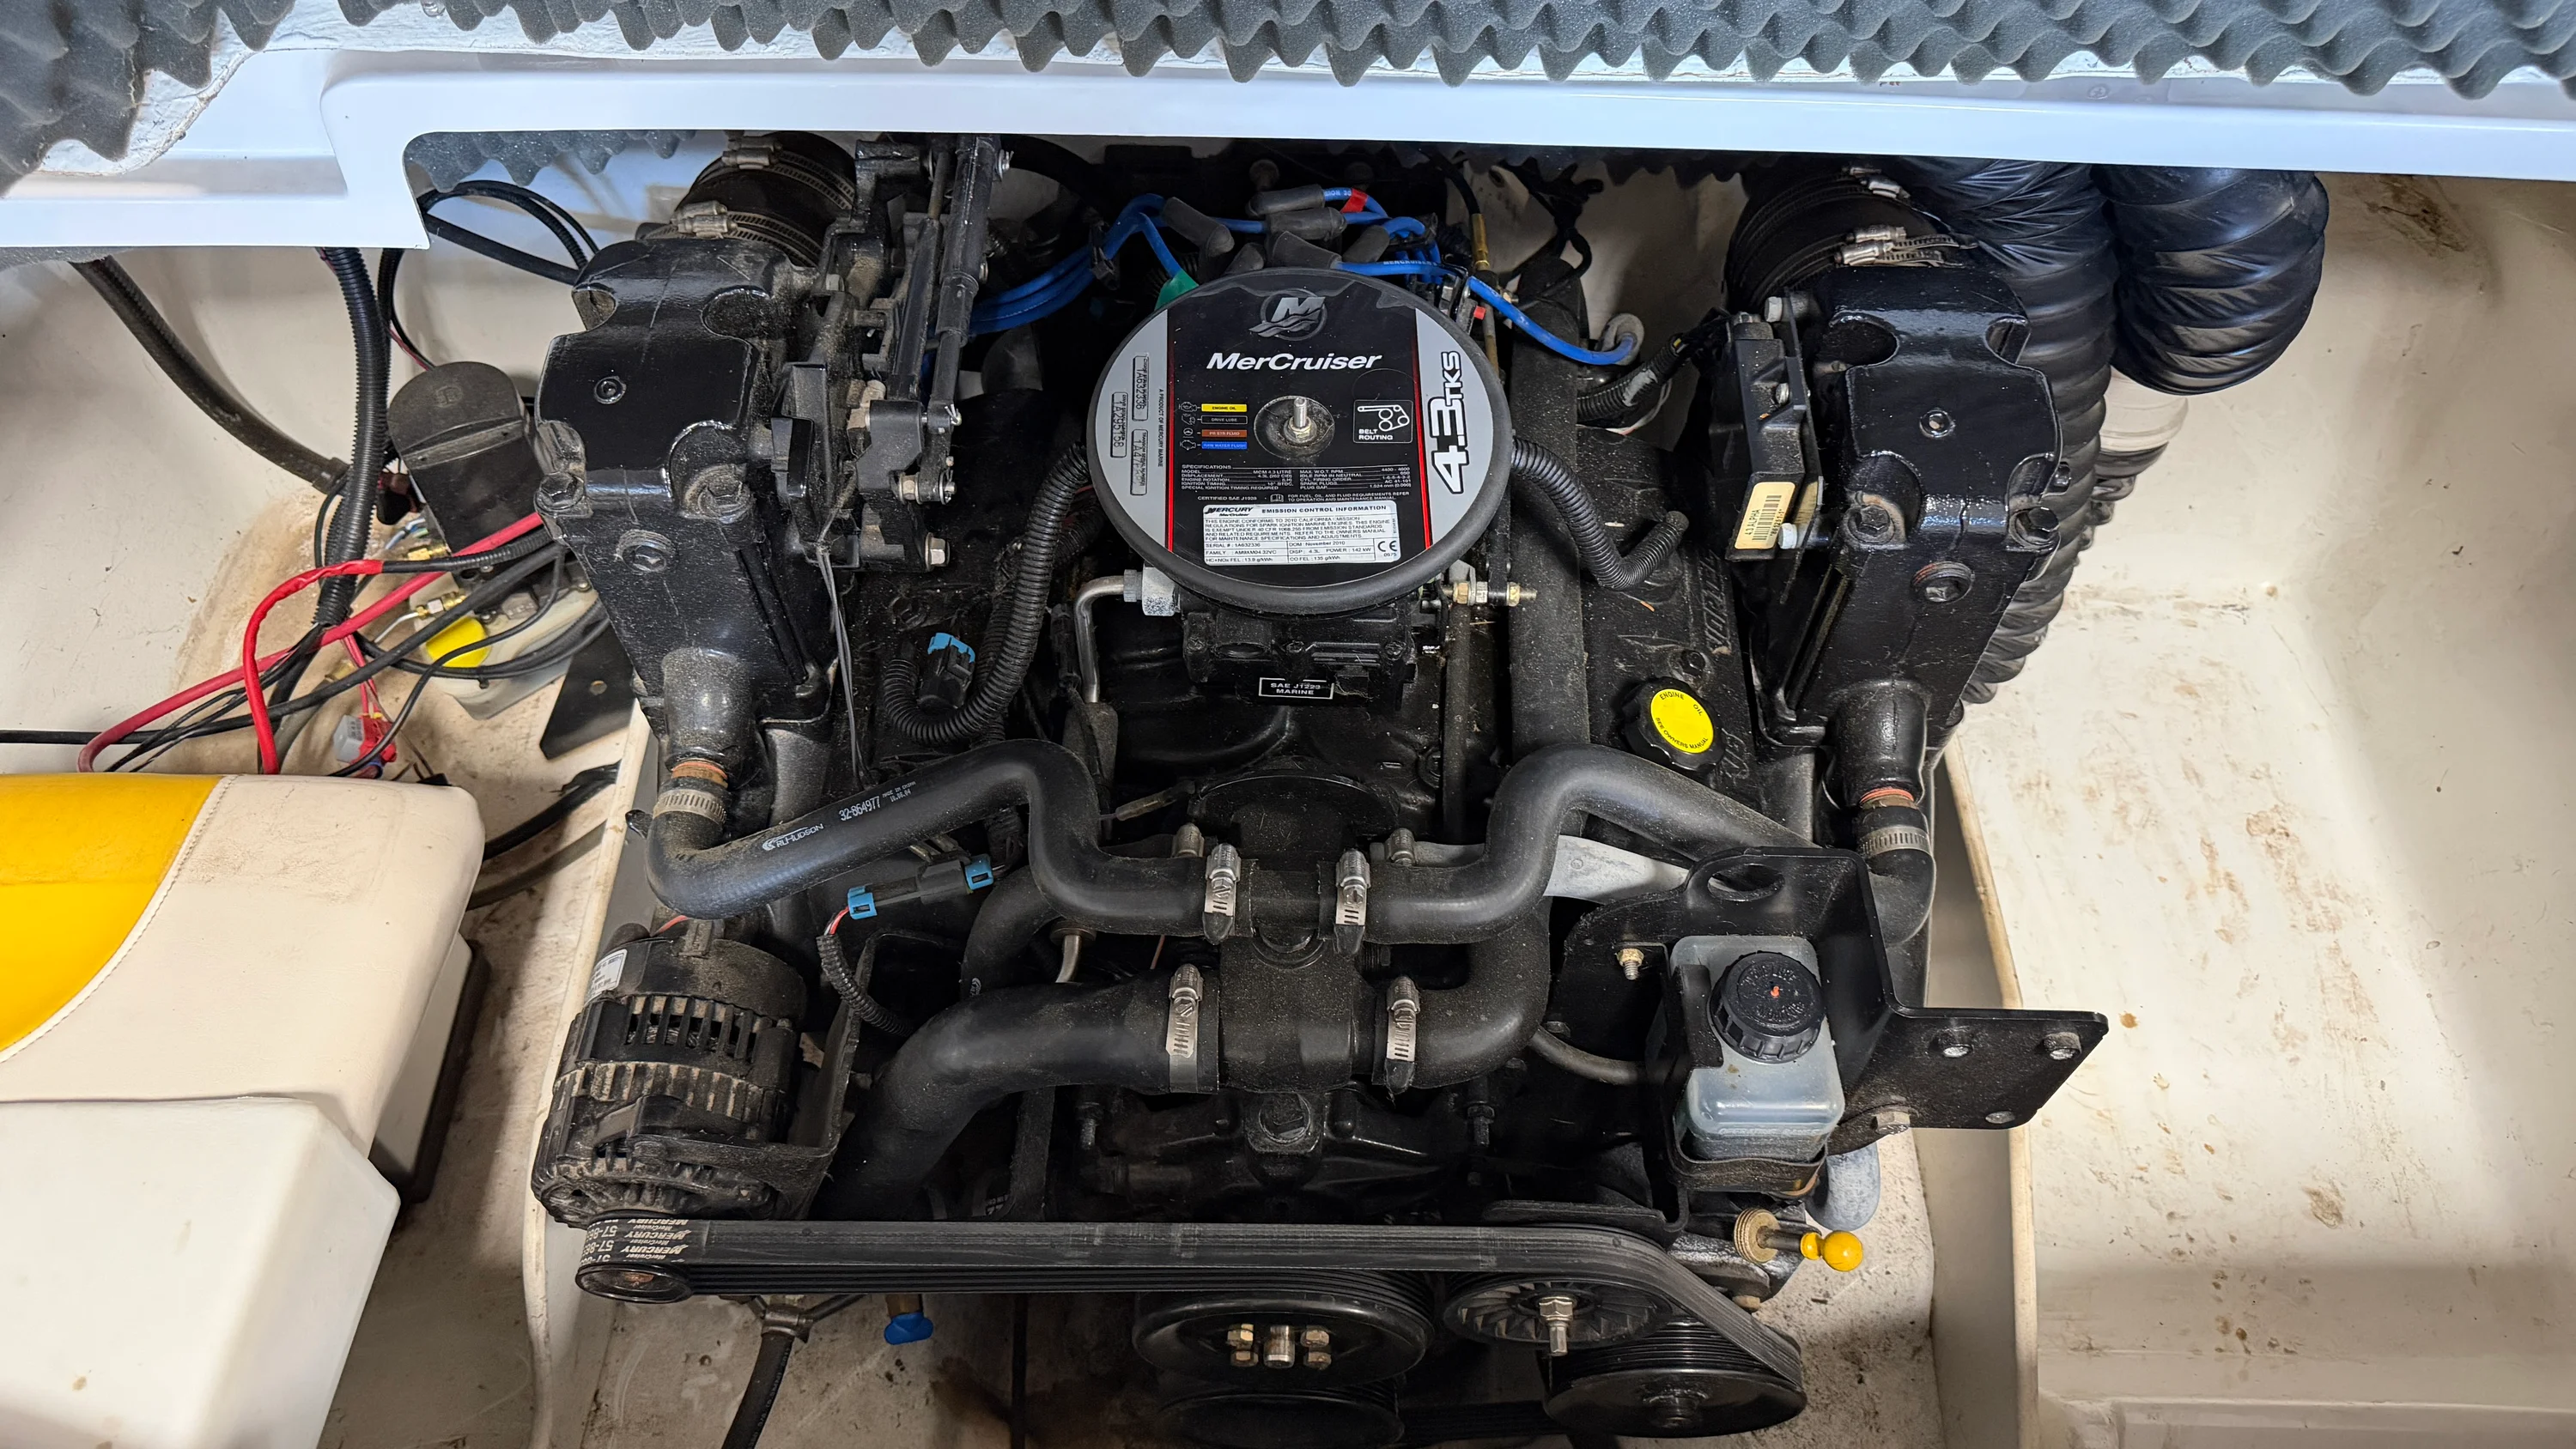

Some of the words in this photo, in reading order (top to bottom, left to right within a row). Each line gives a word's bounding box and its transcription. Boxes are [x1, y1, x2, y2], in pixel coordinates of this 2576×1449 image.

[1206, 352, 1382, 371] MerCruiser
[1136, 367, 1145, 409] 1A632336
[1441, 351, 1464, 406] TKS
[1428, 397, 1469, 494] 4.3
[1204, 506, 1254, 515] MERCURY
[1659, 691, 1685, 700] ENGINE
[1692, 703, 1703, 716] OIL
[1656, 717, 1664, 730] SEE
[1663, 730, 1689, 749] OWNERS
[1689, 737, 1709, 749] MANUAL
[838, 795, 881, 822] 32-864977
[624, 1229, 692, 1240] MERCURY
[620, 1245, 690, 1255] MERCURY
